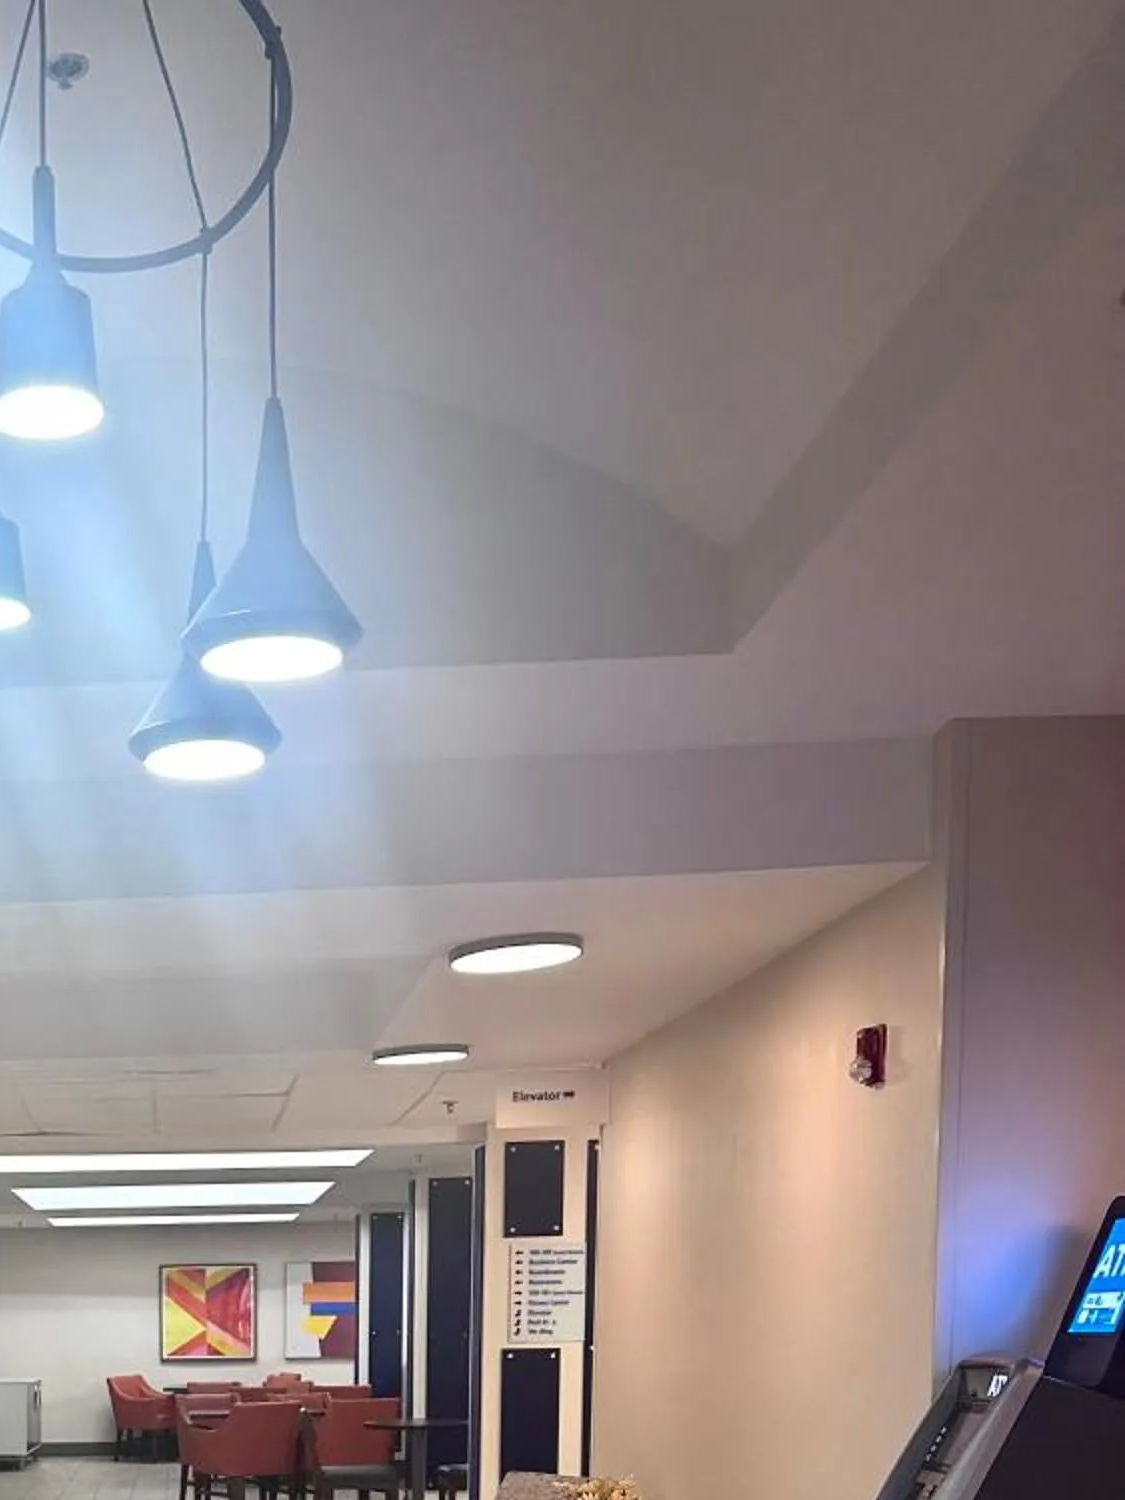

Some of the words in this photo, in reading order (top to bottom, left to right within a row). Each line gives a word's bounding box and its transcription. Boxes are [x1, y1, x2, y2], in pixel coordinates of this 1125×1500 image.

[512, 1090, 560, 1102] Elevator
[1092, 1243, 1125, 1278] AT
[986, 1375, 1008, 1397] AT
